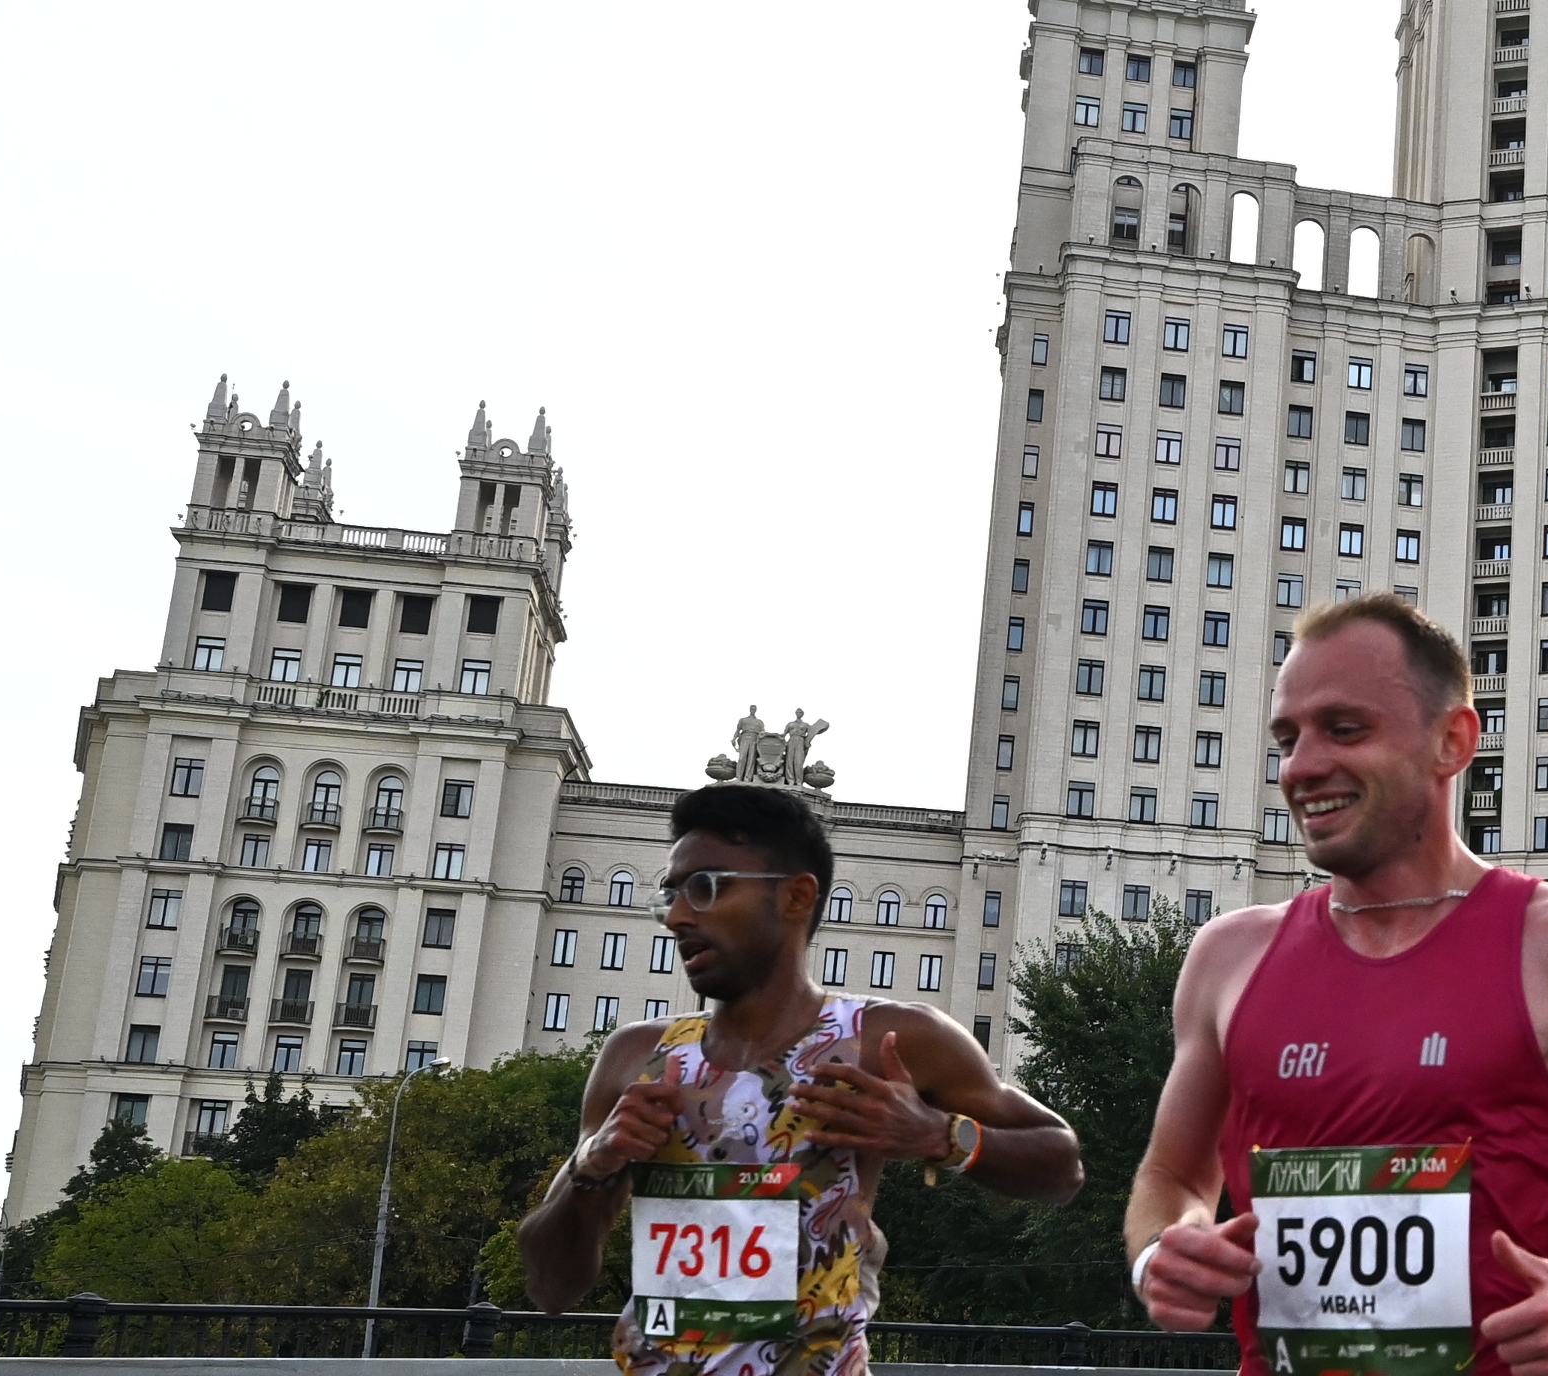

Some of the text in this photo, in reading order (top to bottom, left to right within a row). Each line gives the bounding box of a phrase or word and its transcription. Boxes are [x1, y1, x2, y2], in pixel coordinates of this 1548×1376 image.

[1278, 1042, 1330, 1080] GRi
[649, 1222, 773, 1279] 7316
[1276, 1214, 1435, 1287] 5900
[1320, 1294, 1377, 1315] ИВАН
